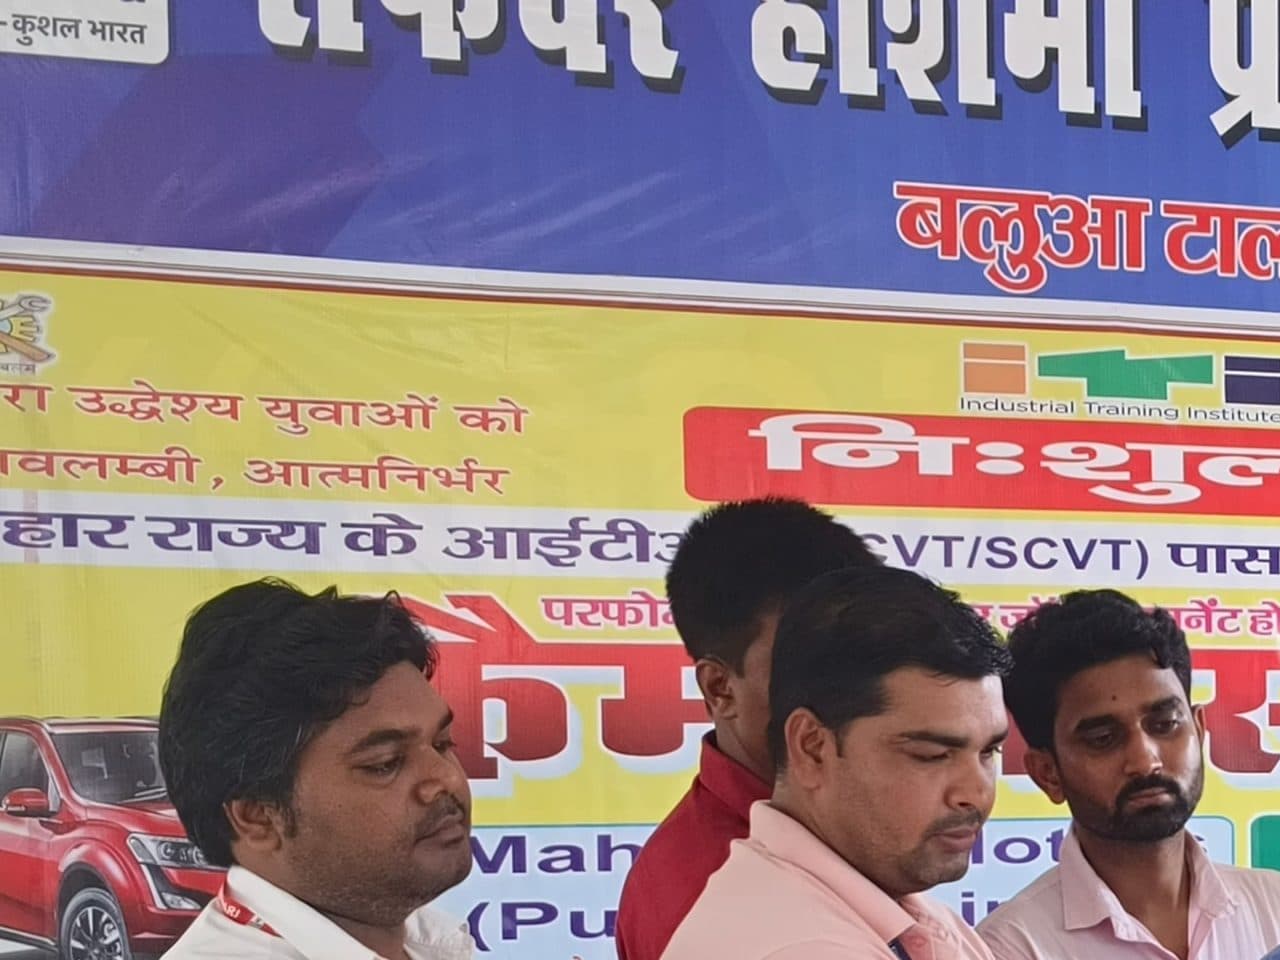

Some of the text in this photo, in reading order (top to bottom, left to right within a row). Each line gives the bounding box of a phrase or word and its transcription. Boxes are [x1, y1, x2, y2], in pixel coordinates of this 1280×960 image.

[11, 14, 148, 46] कुशल भारत
[894, 182, 1152, 294] बलुआ
[0, 384, 53, 412] रा
[258, 393, 439, 435] युवाओं
[453, 397, 529, 434] को
[960, 397, 1075, 415] Industrial
[1084, 401, 1180, 421] Training
[244, 456, 511, 495] आत्मनिर्भर
[0, 512, 134, 549] हार
[145, 516, 327, 556] राज्य
[341, 513, 423, 557] के
